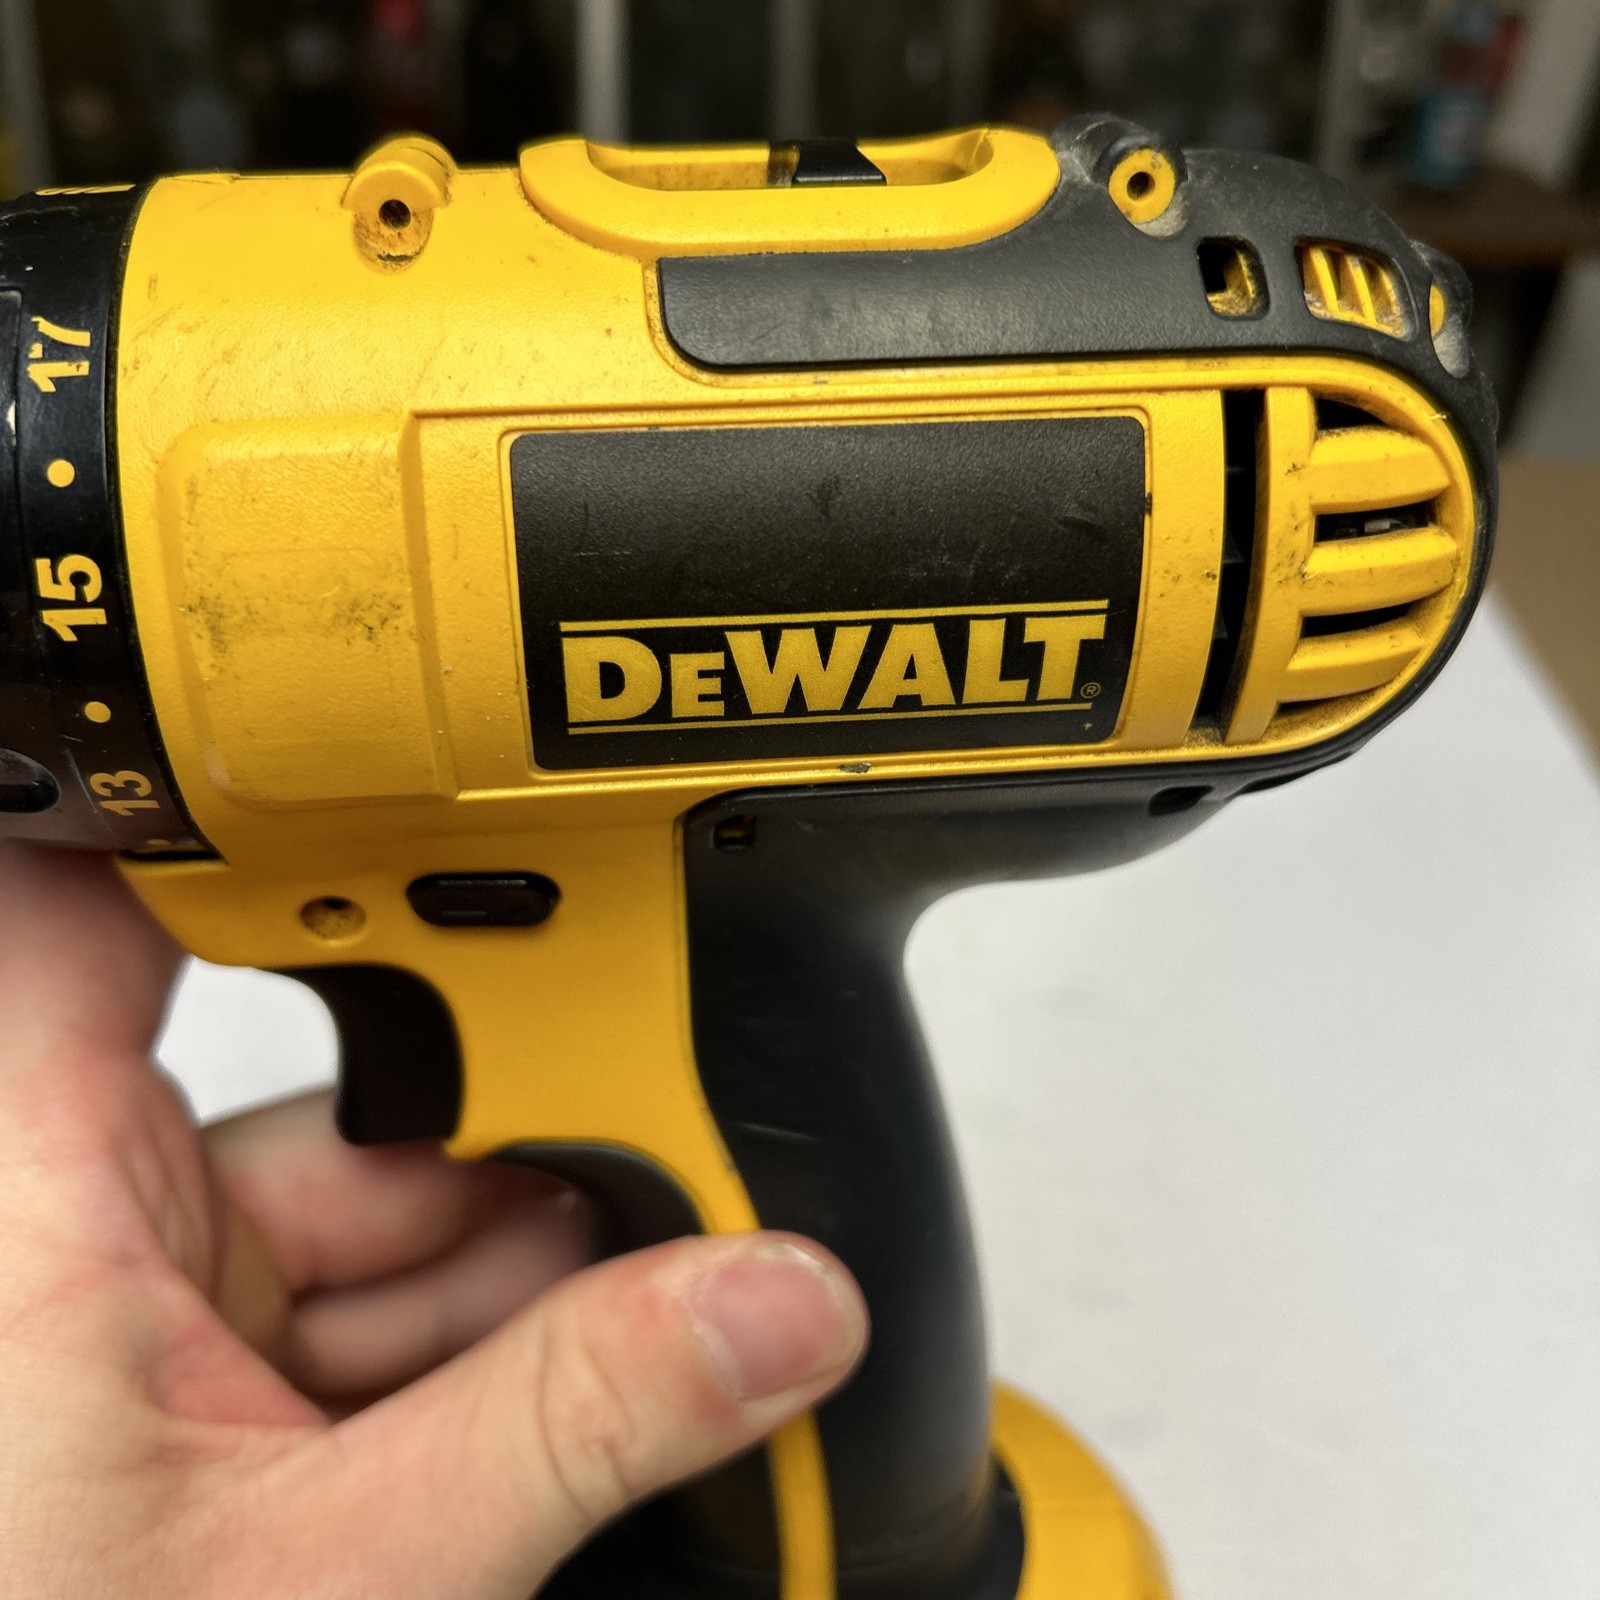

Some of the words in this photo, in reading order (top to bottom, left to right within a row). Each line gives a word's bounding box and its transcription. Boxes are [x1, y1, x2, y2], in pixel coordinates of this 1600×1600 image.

[27, 316, 91, 392] 17
[36, 554, 107, 641] 15
[563, 614, 1106, 723] DEWALT
[89, 769, 161, 817] 13
